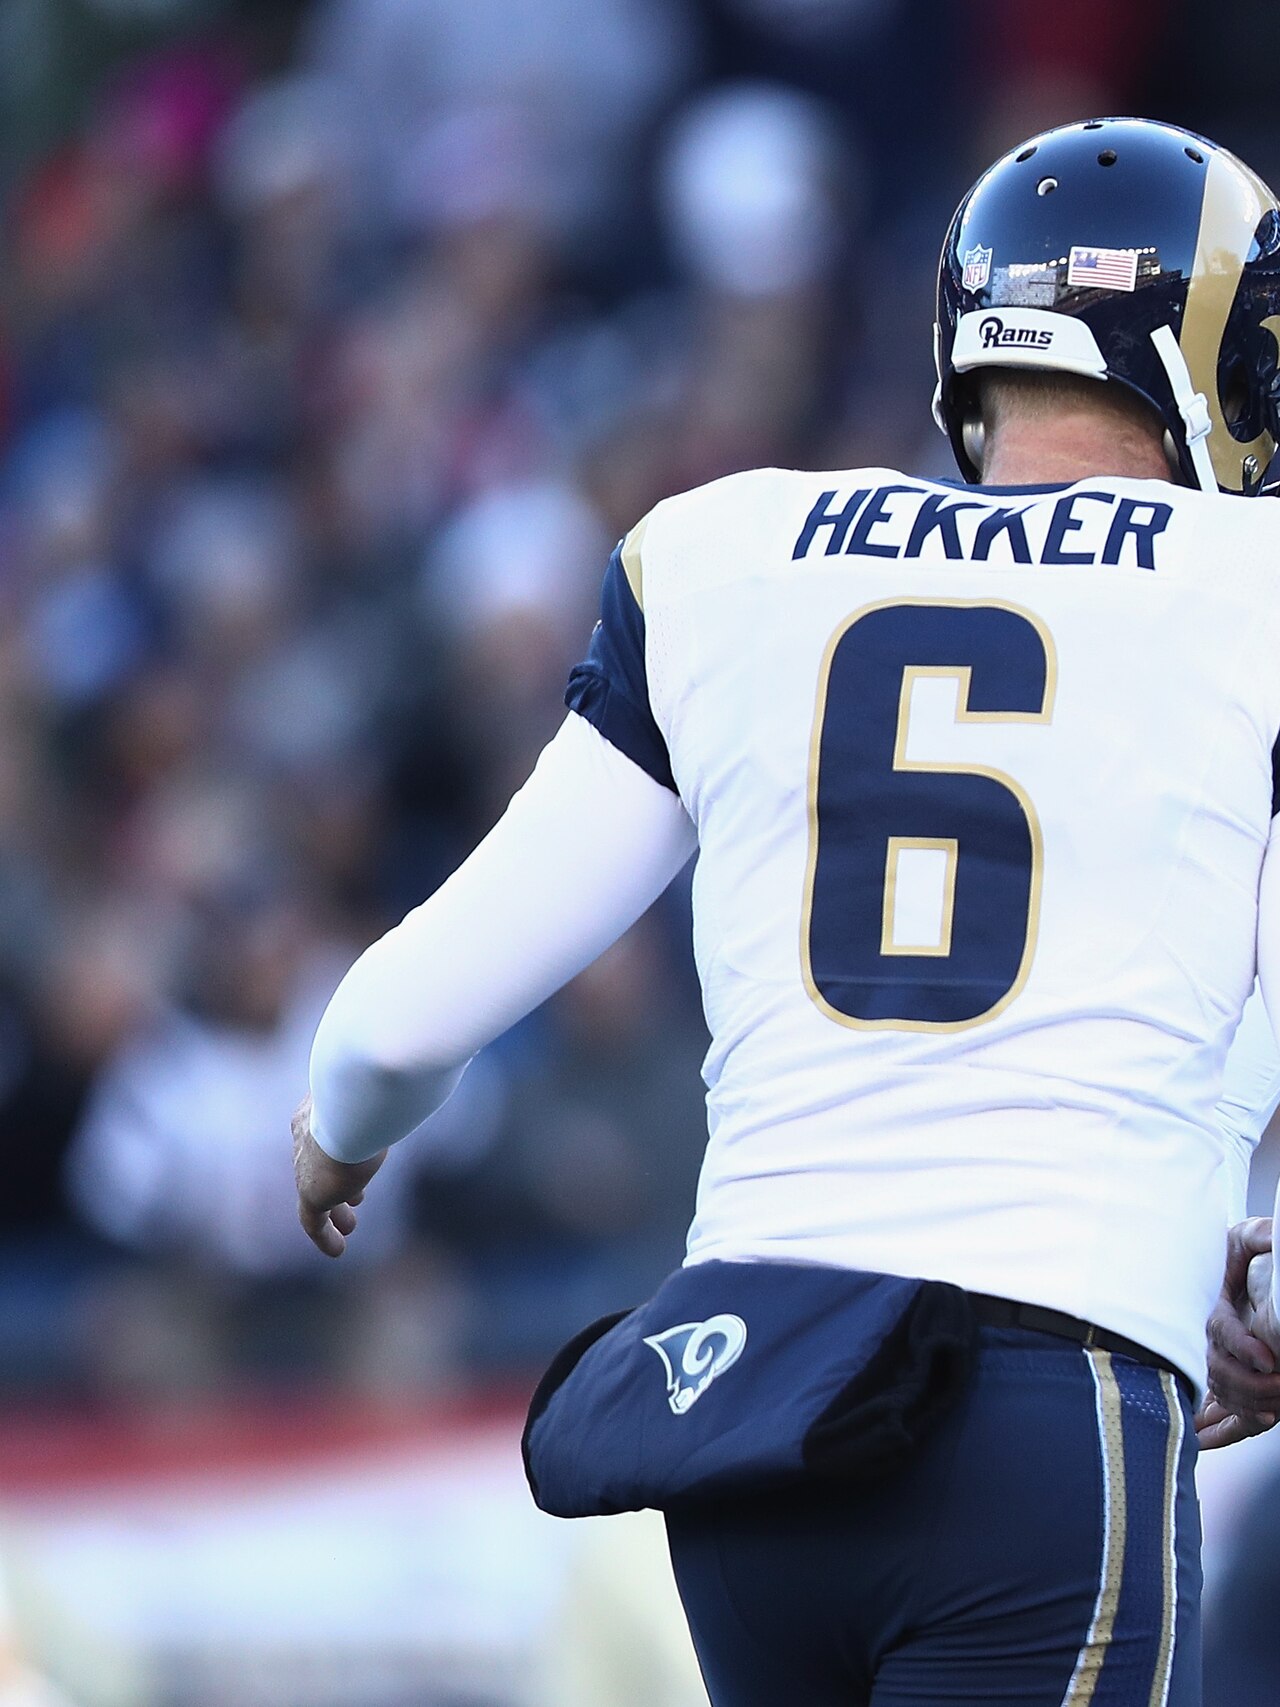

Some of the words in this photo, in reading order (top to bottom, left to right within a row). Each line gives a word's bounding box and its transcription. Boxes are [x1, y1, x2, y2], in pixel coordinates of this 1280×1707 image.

[965, 265, 984, 285] NFL
[979, 316, 1054, 350] Rams
[791, 486, 1174, 570] HEKKER
[800, 596, 1058, 1033] 6
